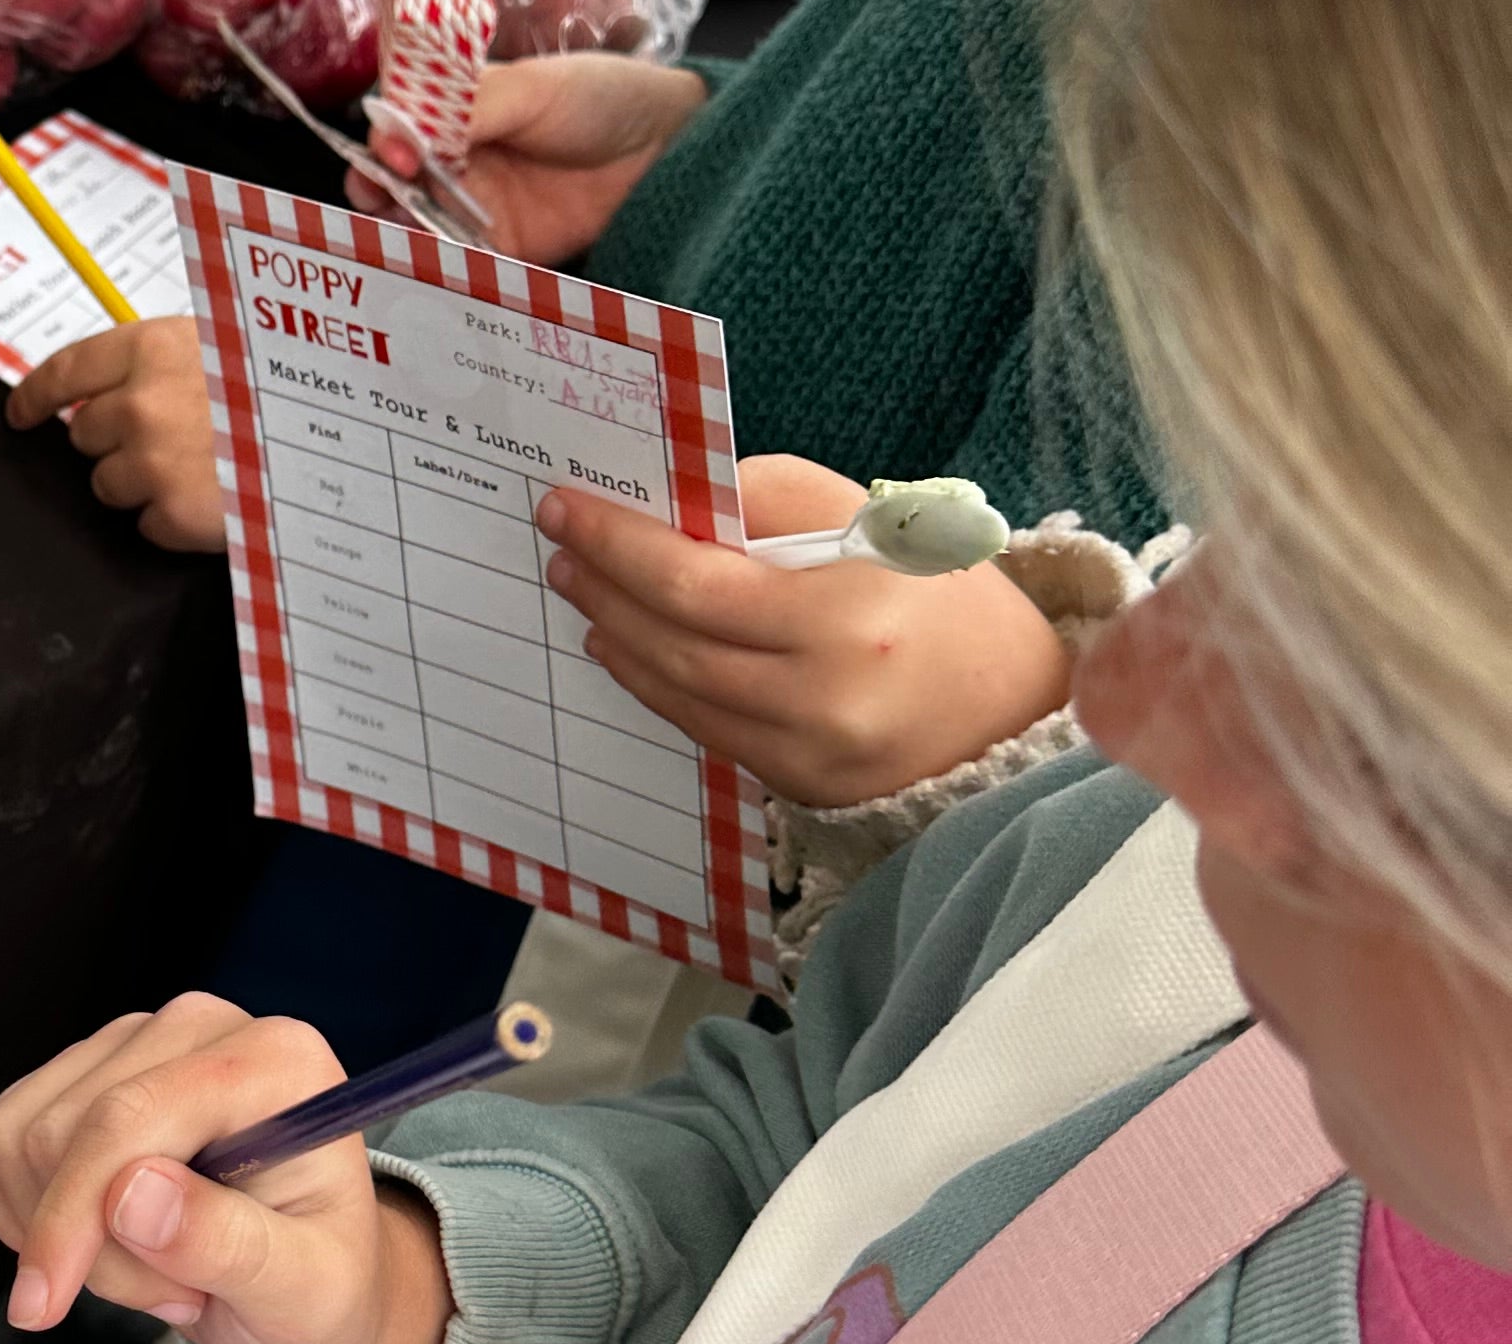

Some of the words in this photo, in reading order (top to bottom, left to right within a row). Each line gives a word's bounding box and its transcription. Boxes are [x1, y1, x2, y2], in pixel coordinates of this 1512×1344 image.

[248, 244, 363, 308] POPPY
[252, 295, 392, 367] STREET
[464, 312, 521, 344] Park:
[454, 351, 545, 395] Country:
[268, 358, 356, 400] Market
[369, 388, 428, 423] Tour
[445, 414, 461, 435] &
[474, 423, 553, 467] Lunch
[567, 457, 651, 503] Bunch
[308, 422, 342, 442] Find
[413, 455, 499, 493] Label/Draw
